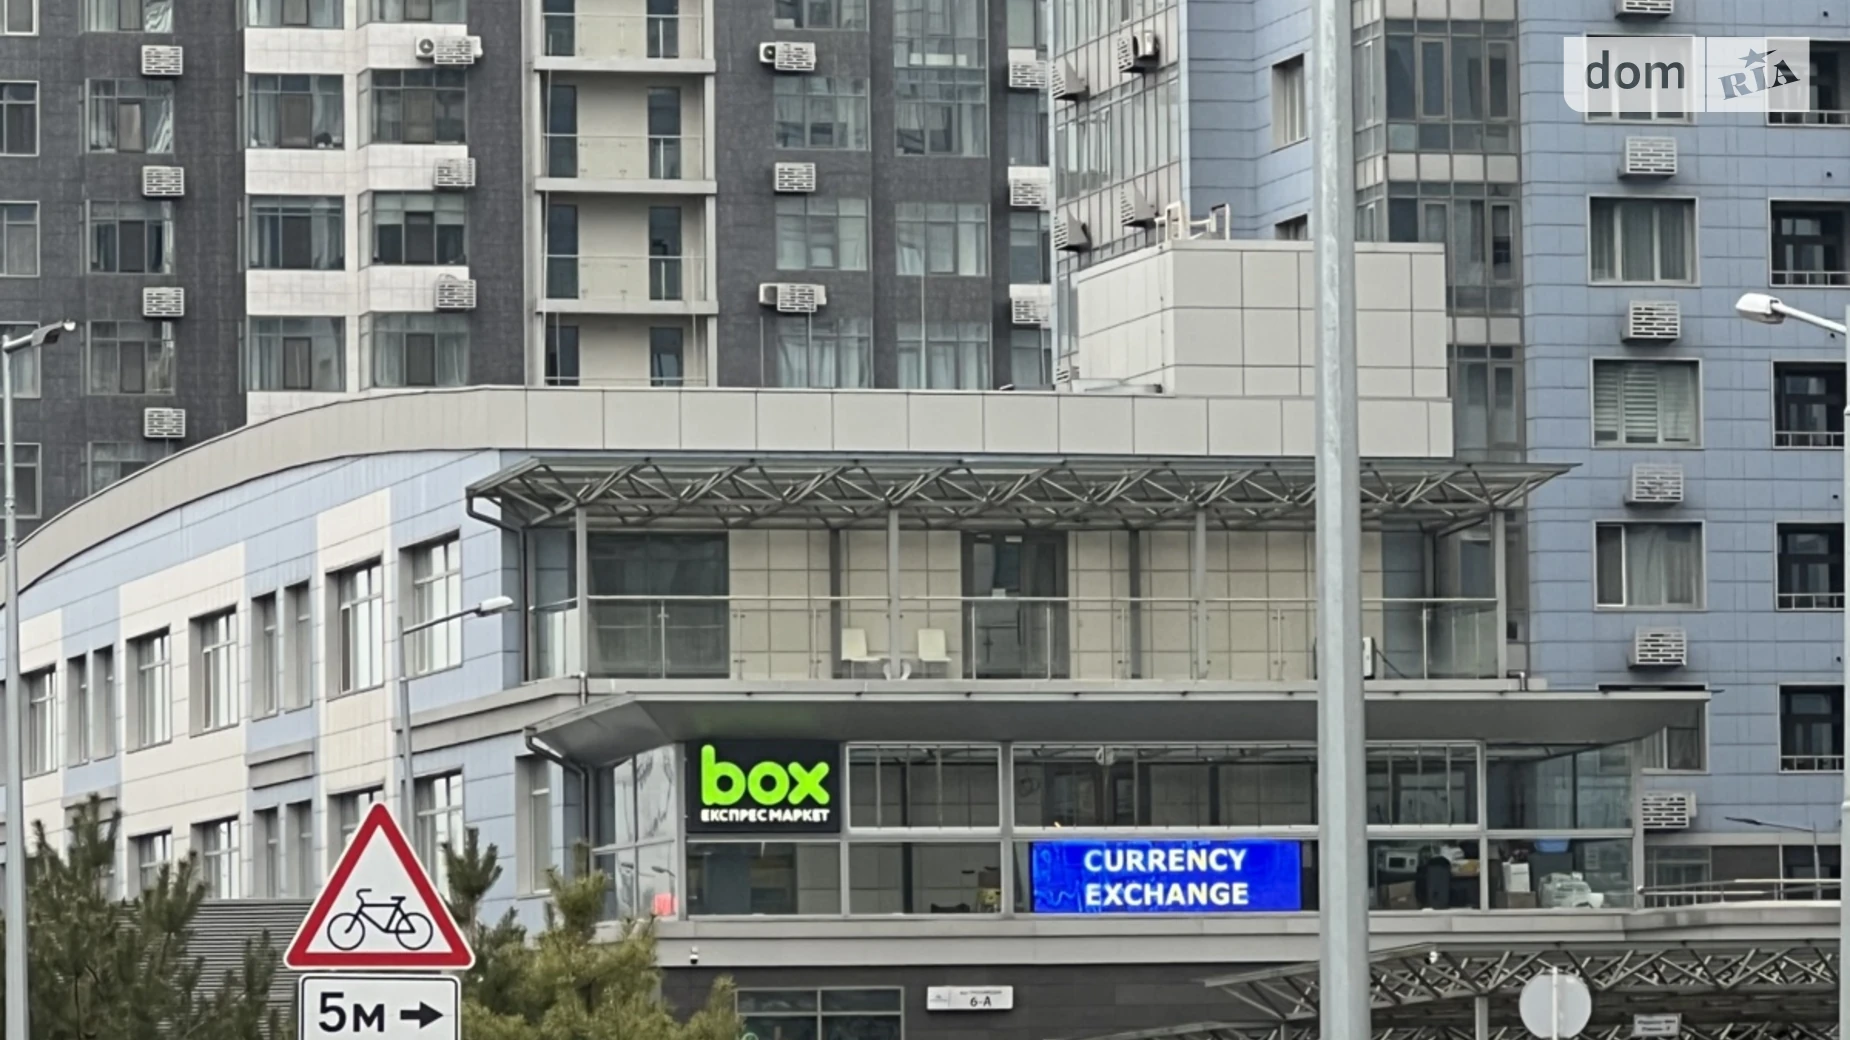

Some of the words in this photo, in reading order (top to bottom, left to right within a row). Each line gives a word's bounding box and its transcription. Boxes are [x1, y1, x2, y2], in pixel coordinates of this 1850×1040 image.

[701, 744, 830, 806] box
[700, 808, 767, 822] ЕКСПРЕС
[768, 808, 831, 822] МАРКЕТ
[1083, 849, 1248, 872] CURRENCY
[1085, 882, 1249, 906] EXCHANGE
